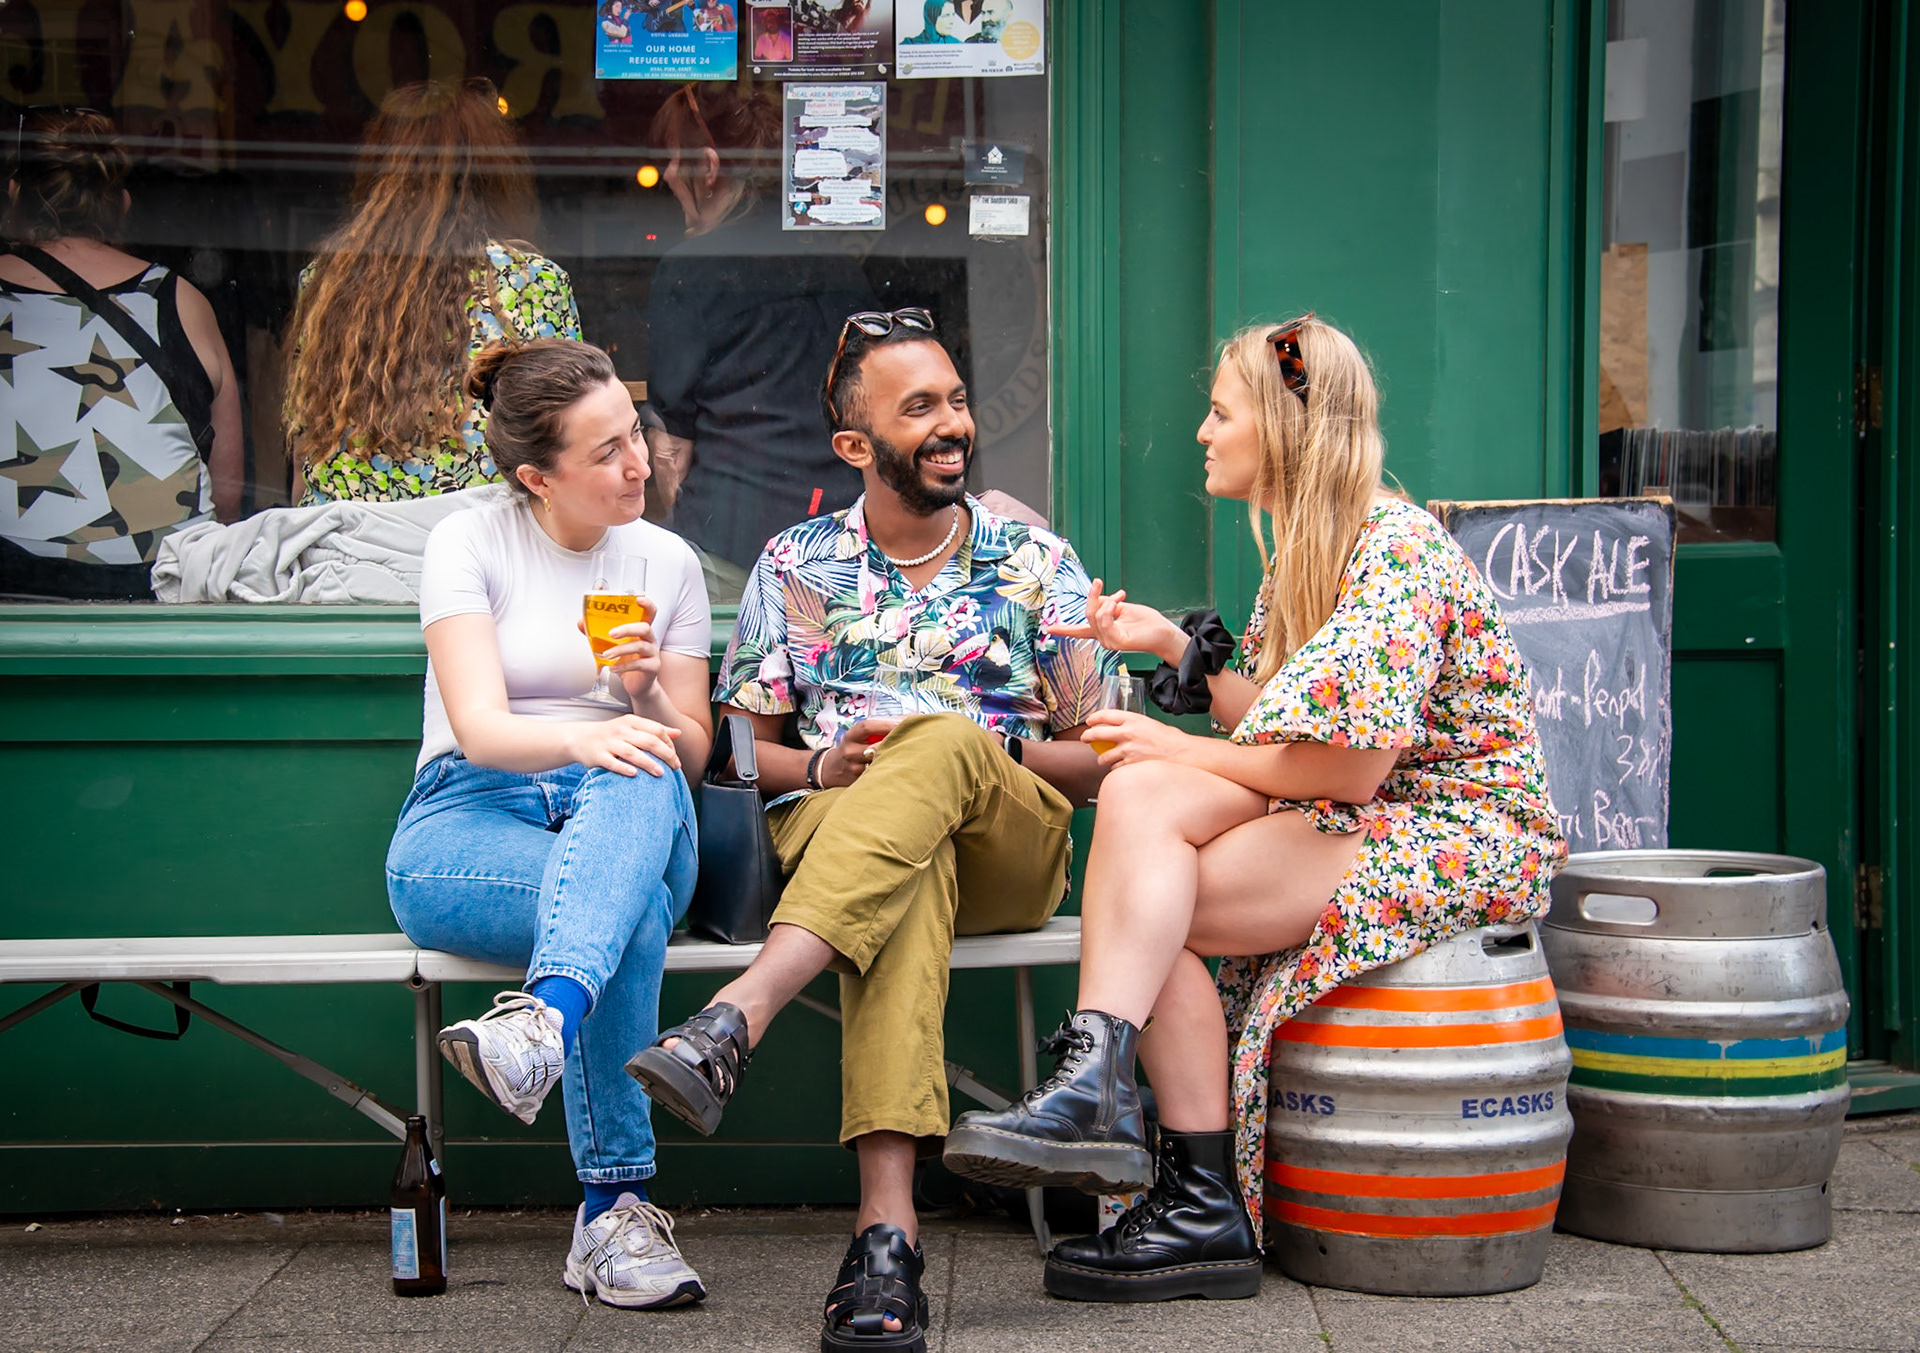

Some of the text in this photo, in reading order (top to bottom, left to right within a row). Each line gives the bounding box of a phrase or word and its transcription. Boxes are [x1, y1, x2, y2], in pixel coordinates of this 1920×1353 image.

[645, 45, 696, 53] OUR HOME
[629, 56, 710, 65] REFUGEE WEEK 24
[1485, 523, 1651, 607] CASK ALE
[1269, 1089, 1554, 1119] ASKS ECASKS
